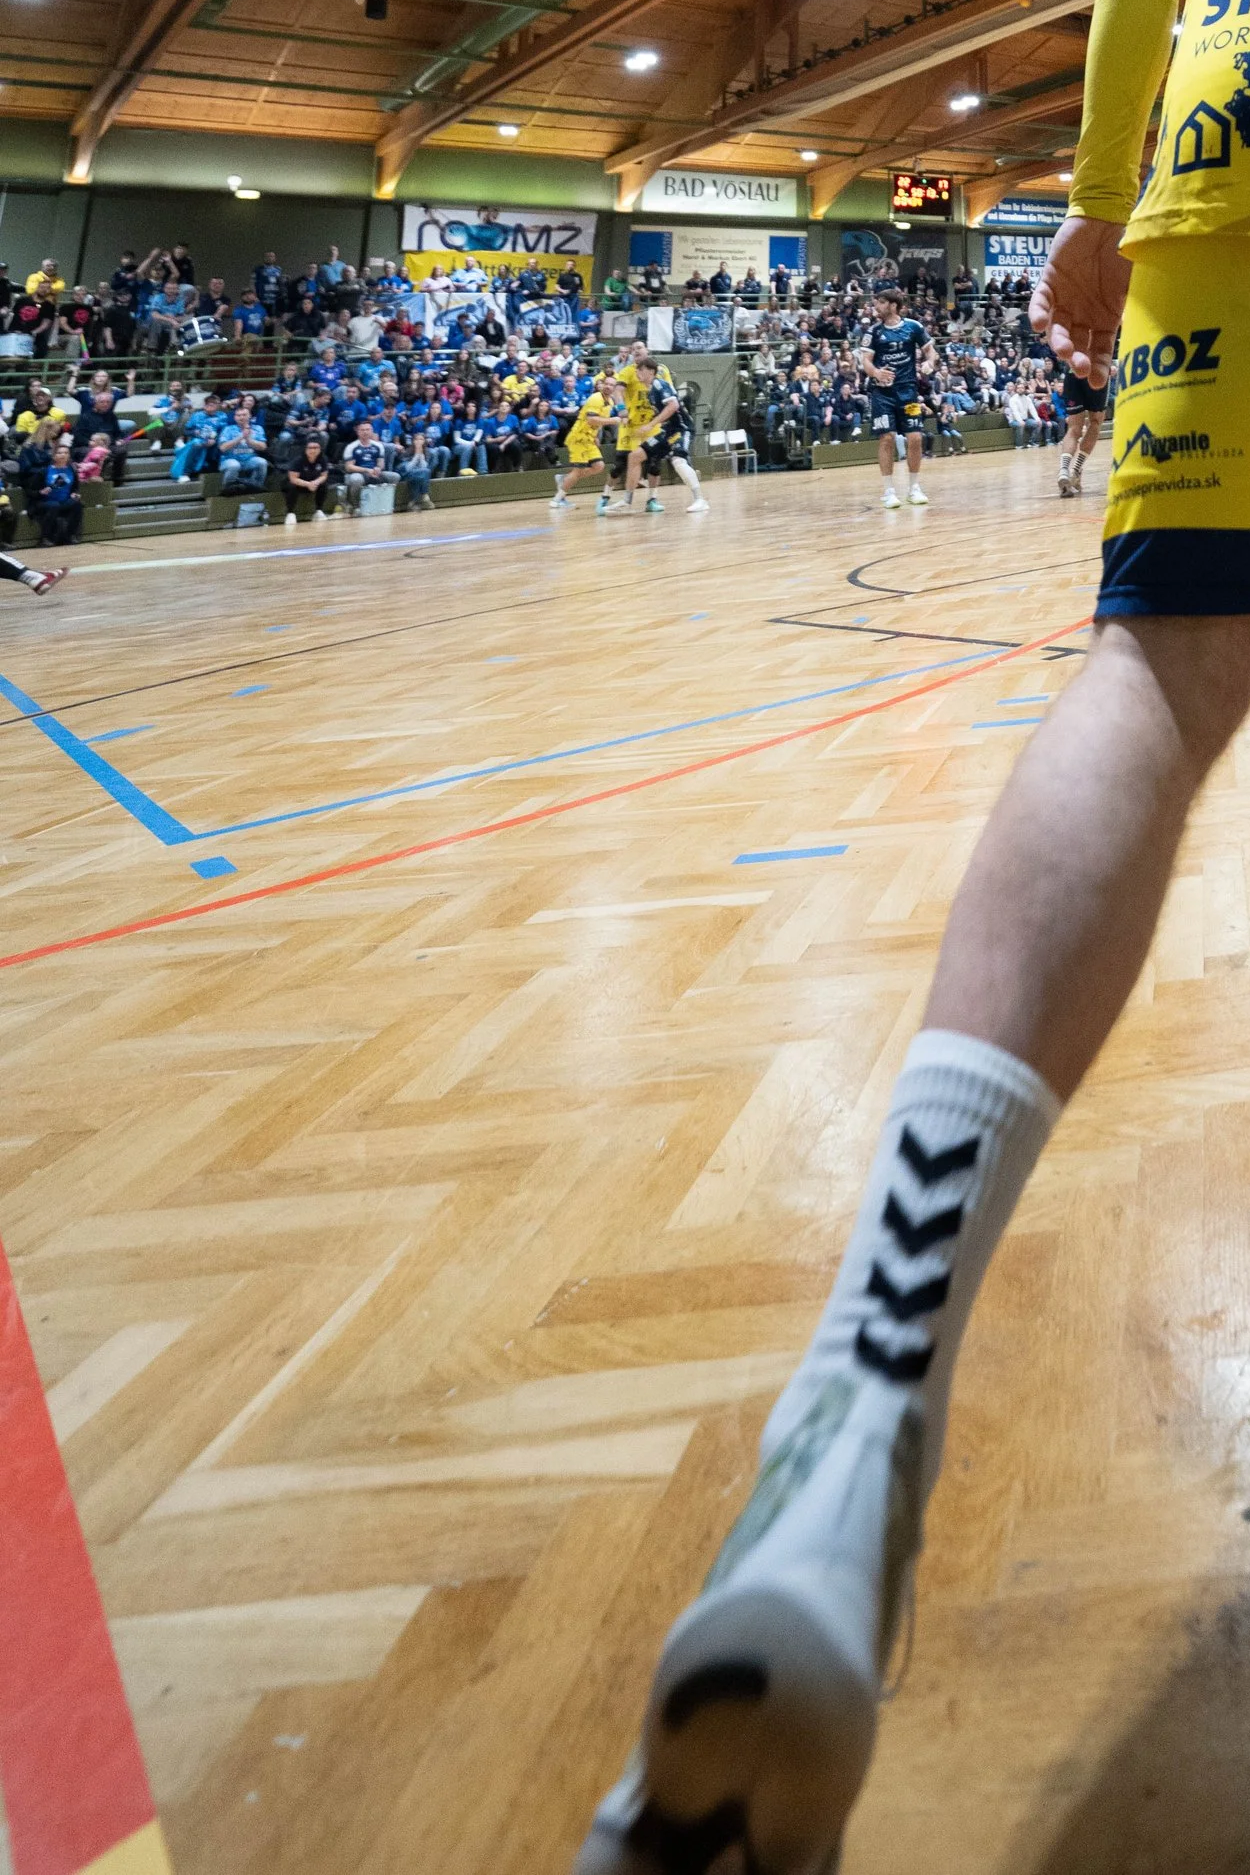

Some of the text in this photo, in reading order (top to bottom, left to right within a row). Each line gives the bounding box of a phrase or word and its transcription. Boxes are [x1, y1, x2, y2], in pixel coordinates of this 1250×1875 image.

[664, 176, 779, 202] BAD VÖSLAU
[998, 255, 1030, 265] BADEN
